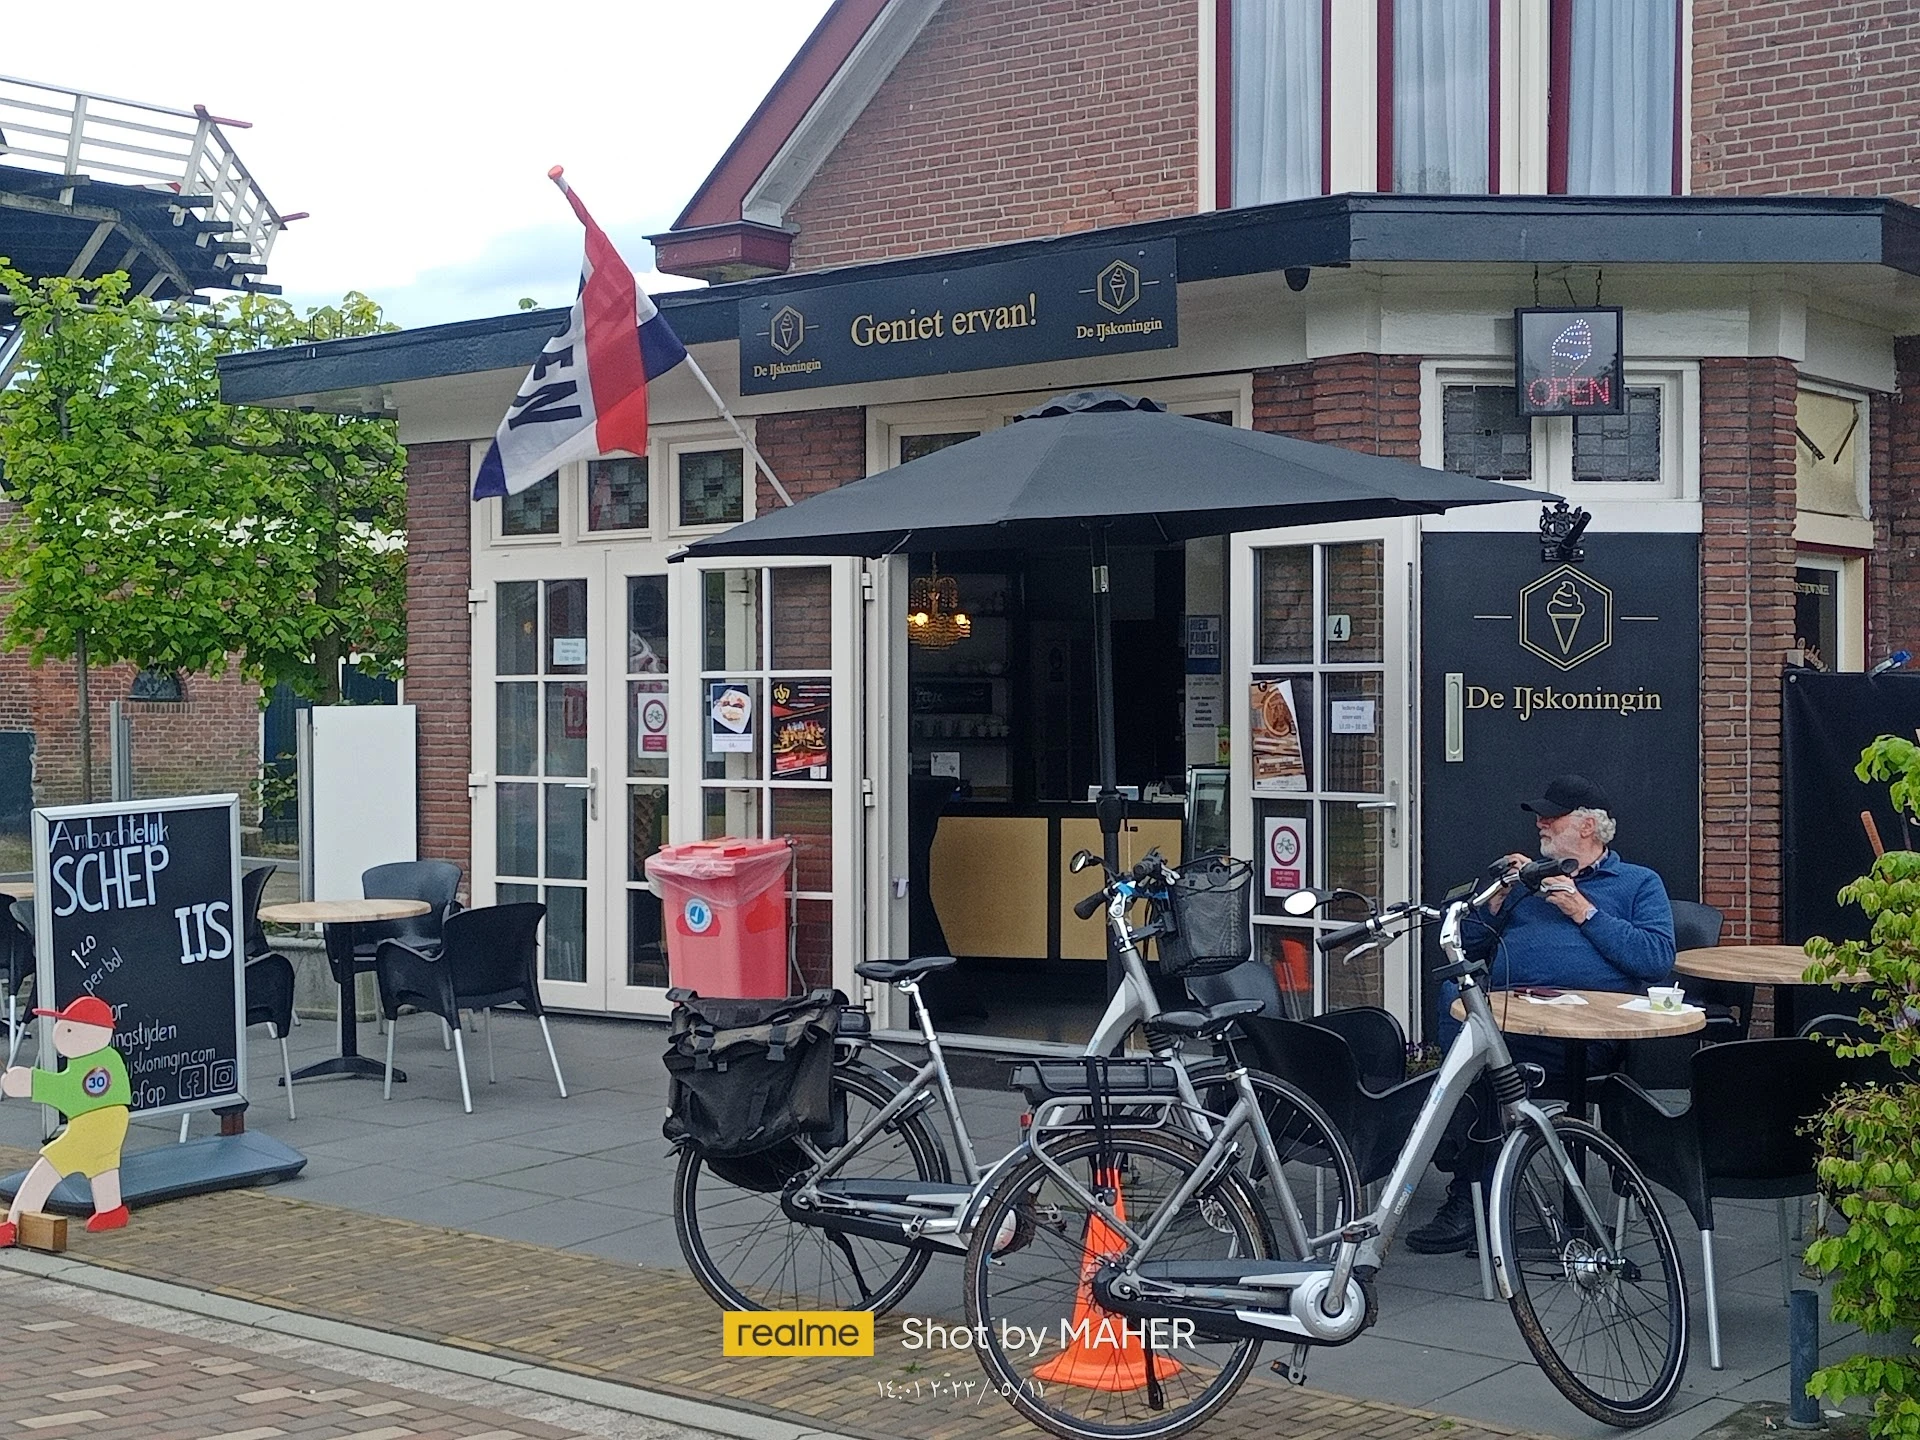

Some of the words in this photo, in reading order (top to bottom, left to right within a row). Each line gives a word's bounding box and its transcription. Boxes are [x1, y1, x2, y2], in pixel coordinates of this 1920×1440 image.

[851, 308, 944, 347] Geniet
[952, 292, 1037, 335] ervan!
[1076, 325, 1094, 339] De
[1096, 318, 1163, 342] IJskoningin
[754, 365, 768, 378] De
[769, 358, 822, 380] IJskoningin
[1528, 376, 1610, 406] OPEN
[1333, 617, 1343, 639] 4
[1466, 686, 1505, 709] De
[1513, 686, 1662, 721] IJskoningin
[50, 813, 170, 853] Ambachtelijk
[53, 844, 170, 917] SCHEP
[175, 901, 232, 964] IJS
[82, 968, 104, 997] per
[101, 947, 124, 973] bol
[111, 1003, 128, 1021] or
[112, 1019, 177, 1056] ingstijden
[88, 1077, 105, 1088] 30
